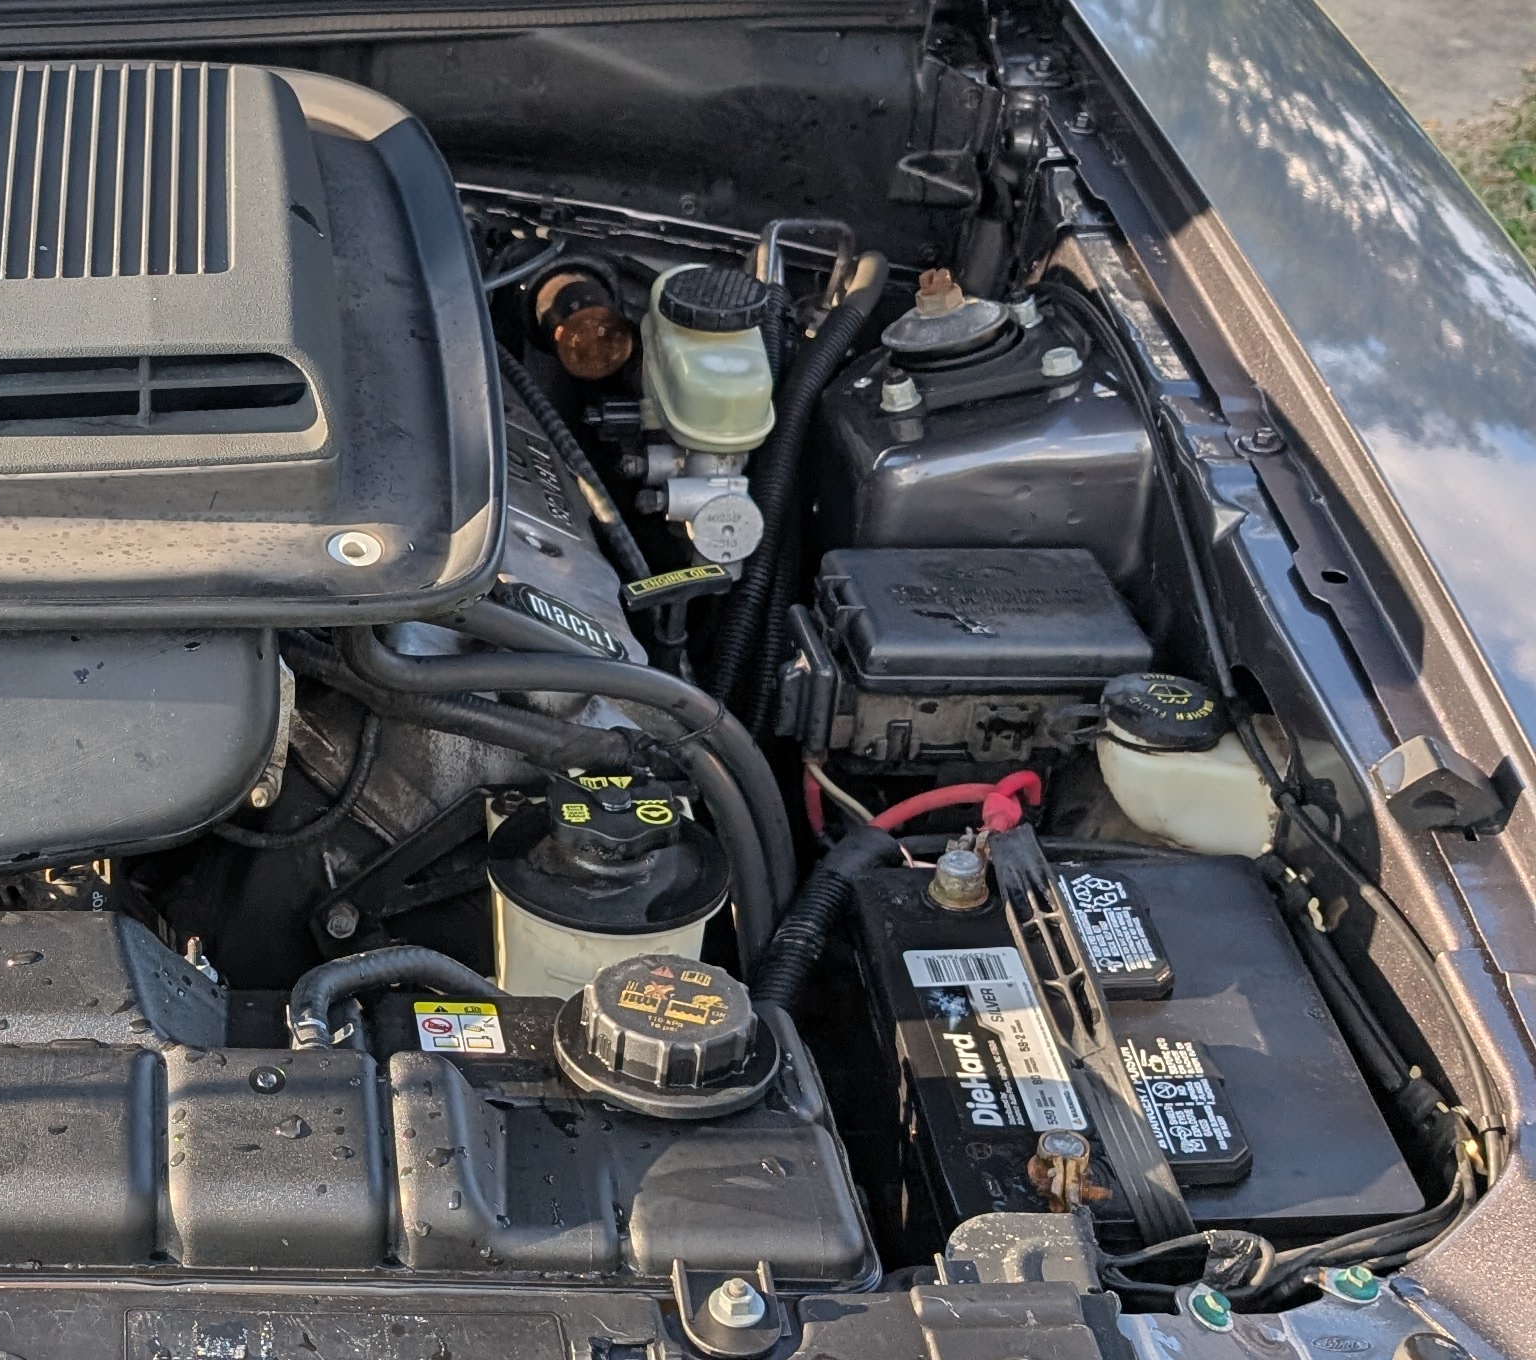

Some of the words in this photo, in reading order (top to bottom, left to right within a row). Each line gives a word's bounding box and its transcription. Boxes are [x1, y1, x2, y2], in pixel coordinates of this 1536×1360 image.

[644, 572, 685, 590] ENGINE
[690, 567, 712, 579] OIL
[528, 592, 604, 646] mach
[980, 987, 1004, 1022] SILVER
[943, 1032, 1005, 1127] DieHard
[1120, 1047, 1142, 1084] POISON
[1043, 1110, 1059, 1125] 550
[1139, 1094, 1164, 1138] DANGER
